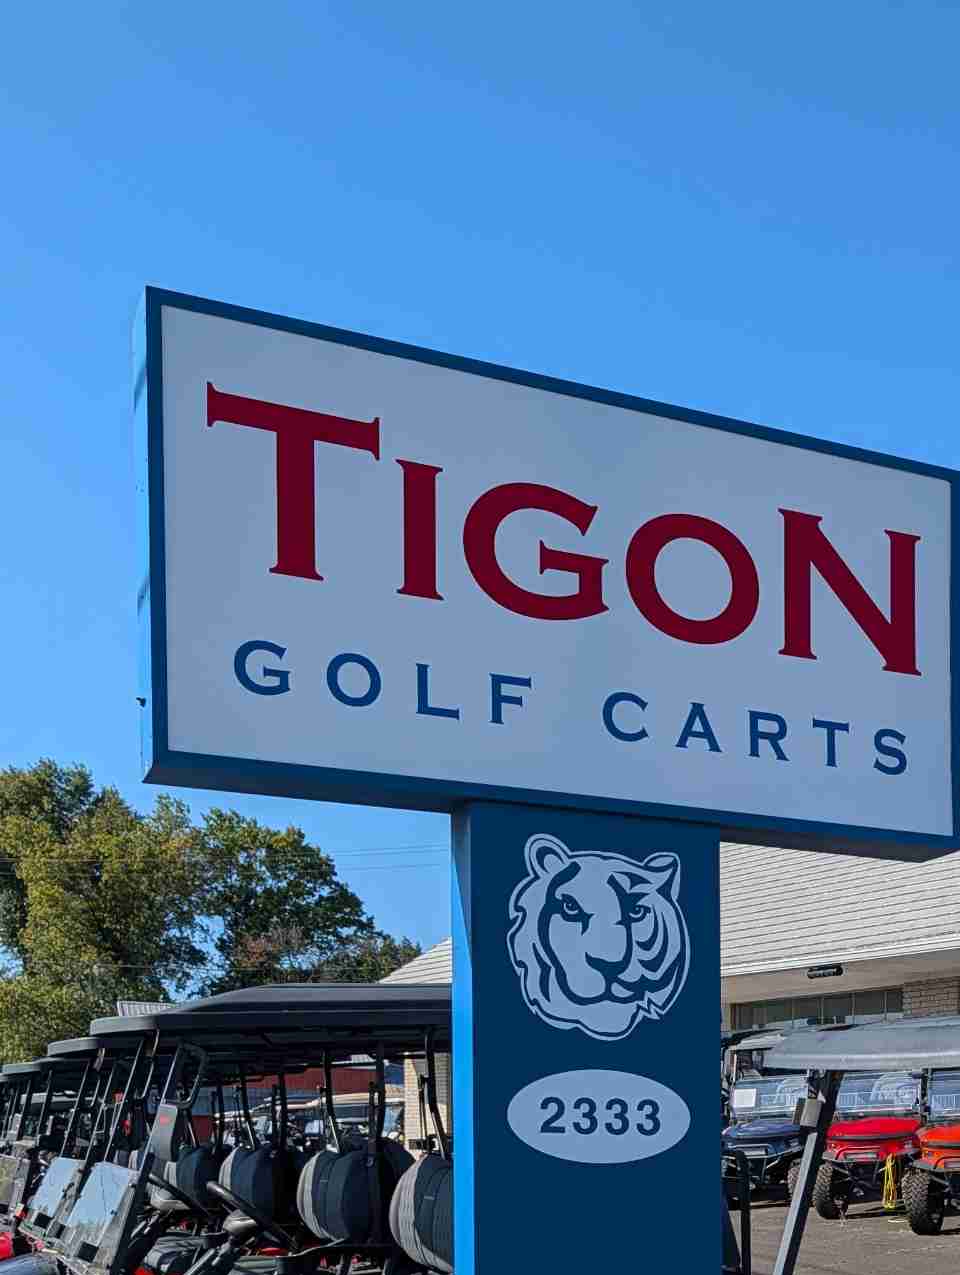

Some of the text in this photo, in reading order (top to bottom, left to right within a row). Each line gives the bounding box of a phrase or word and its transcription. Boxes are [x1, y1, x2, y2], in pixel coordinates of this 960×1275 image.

[206, 380, 922, 677] TIGON
[232, 639, 909, 776] GOLF CARTS
[539, 1096, 662, 1137] 2333
